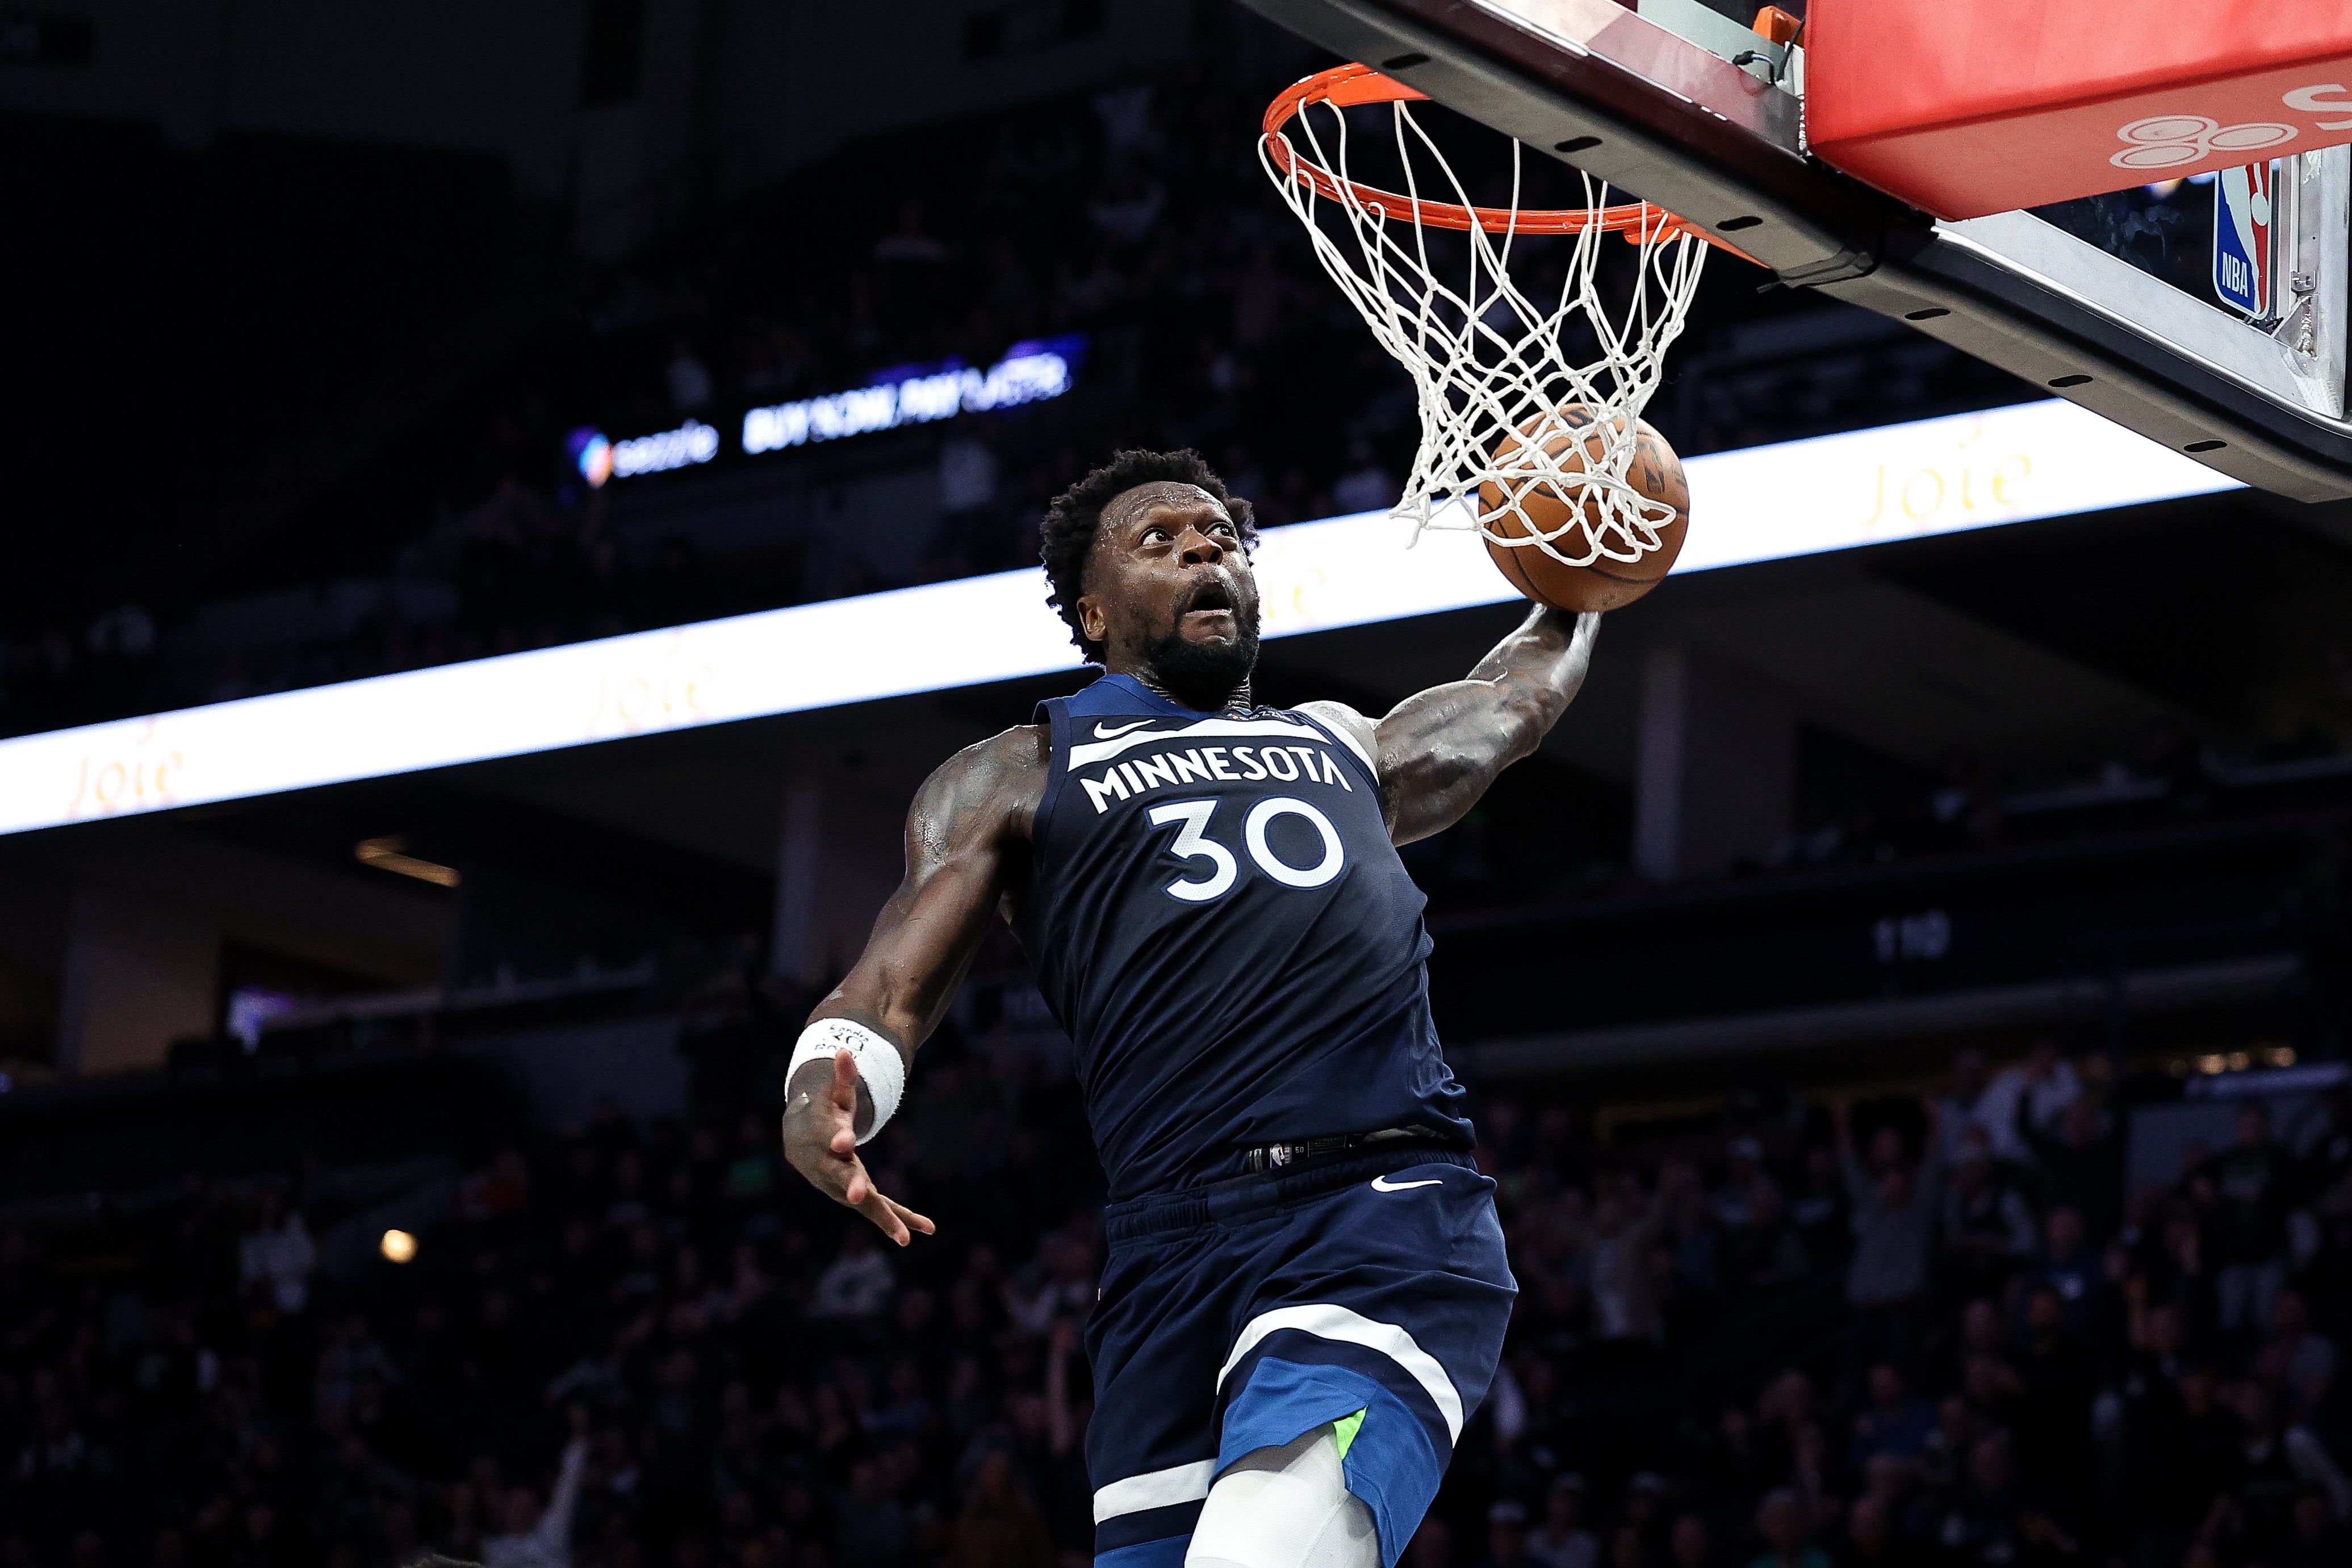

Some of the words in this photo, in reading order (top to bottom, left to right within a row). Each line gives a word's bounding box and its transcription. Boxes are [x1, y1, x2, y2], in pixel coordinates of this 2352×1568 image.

[2222, 251, 2249, 297] NBA
[1080, 747, 1353, 814] MINNESOTA
[1145, 795, 1347, 903] 30
